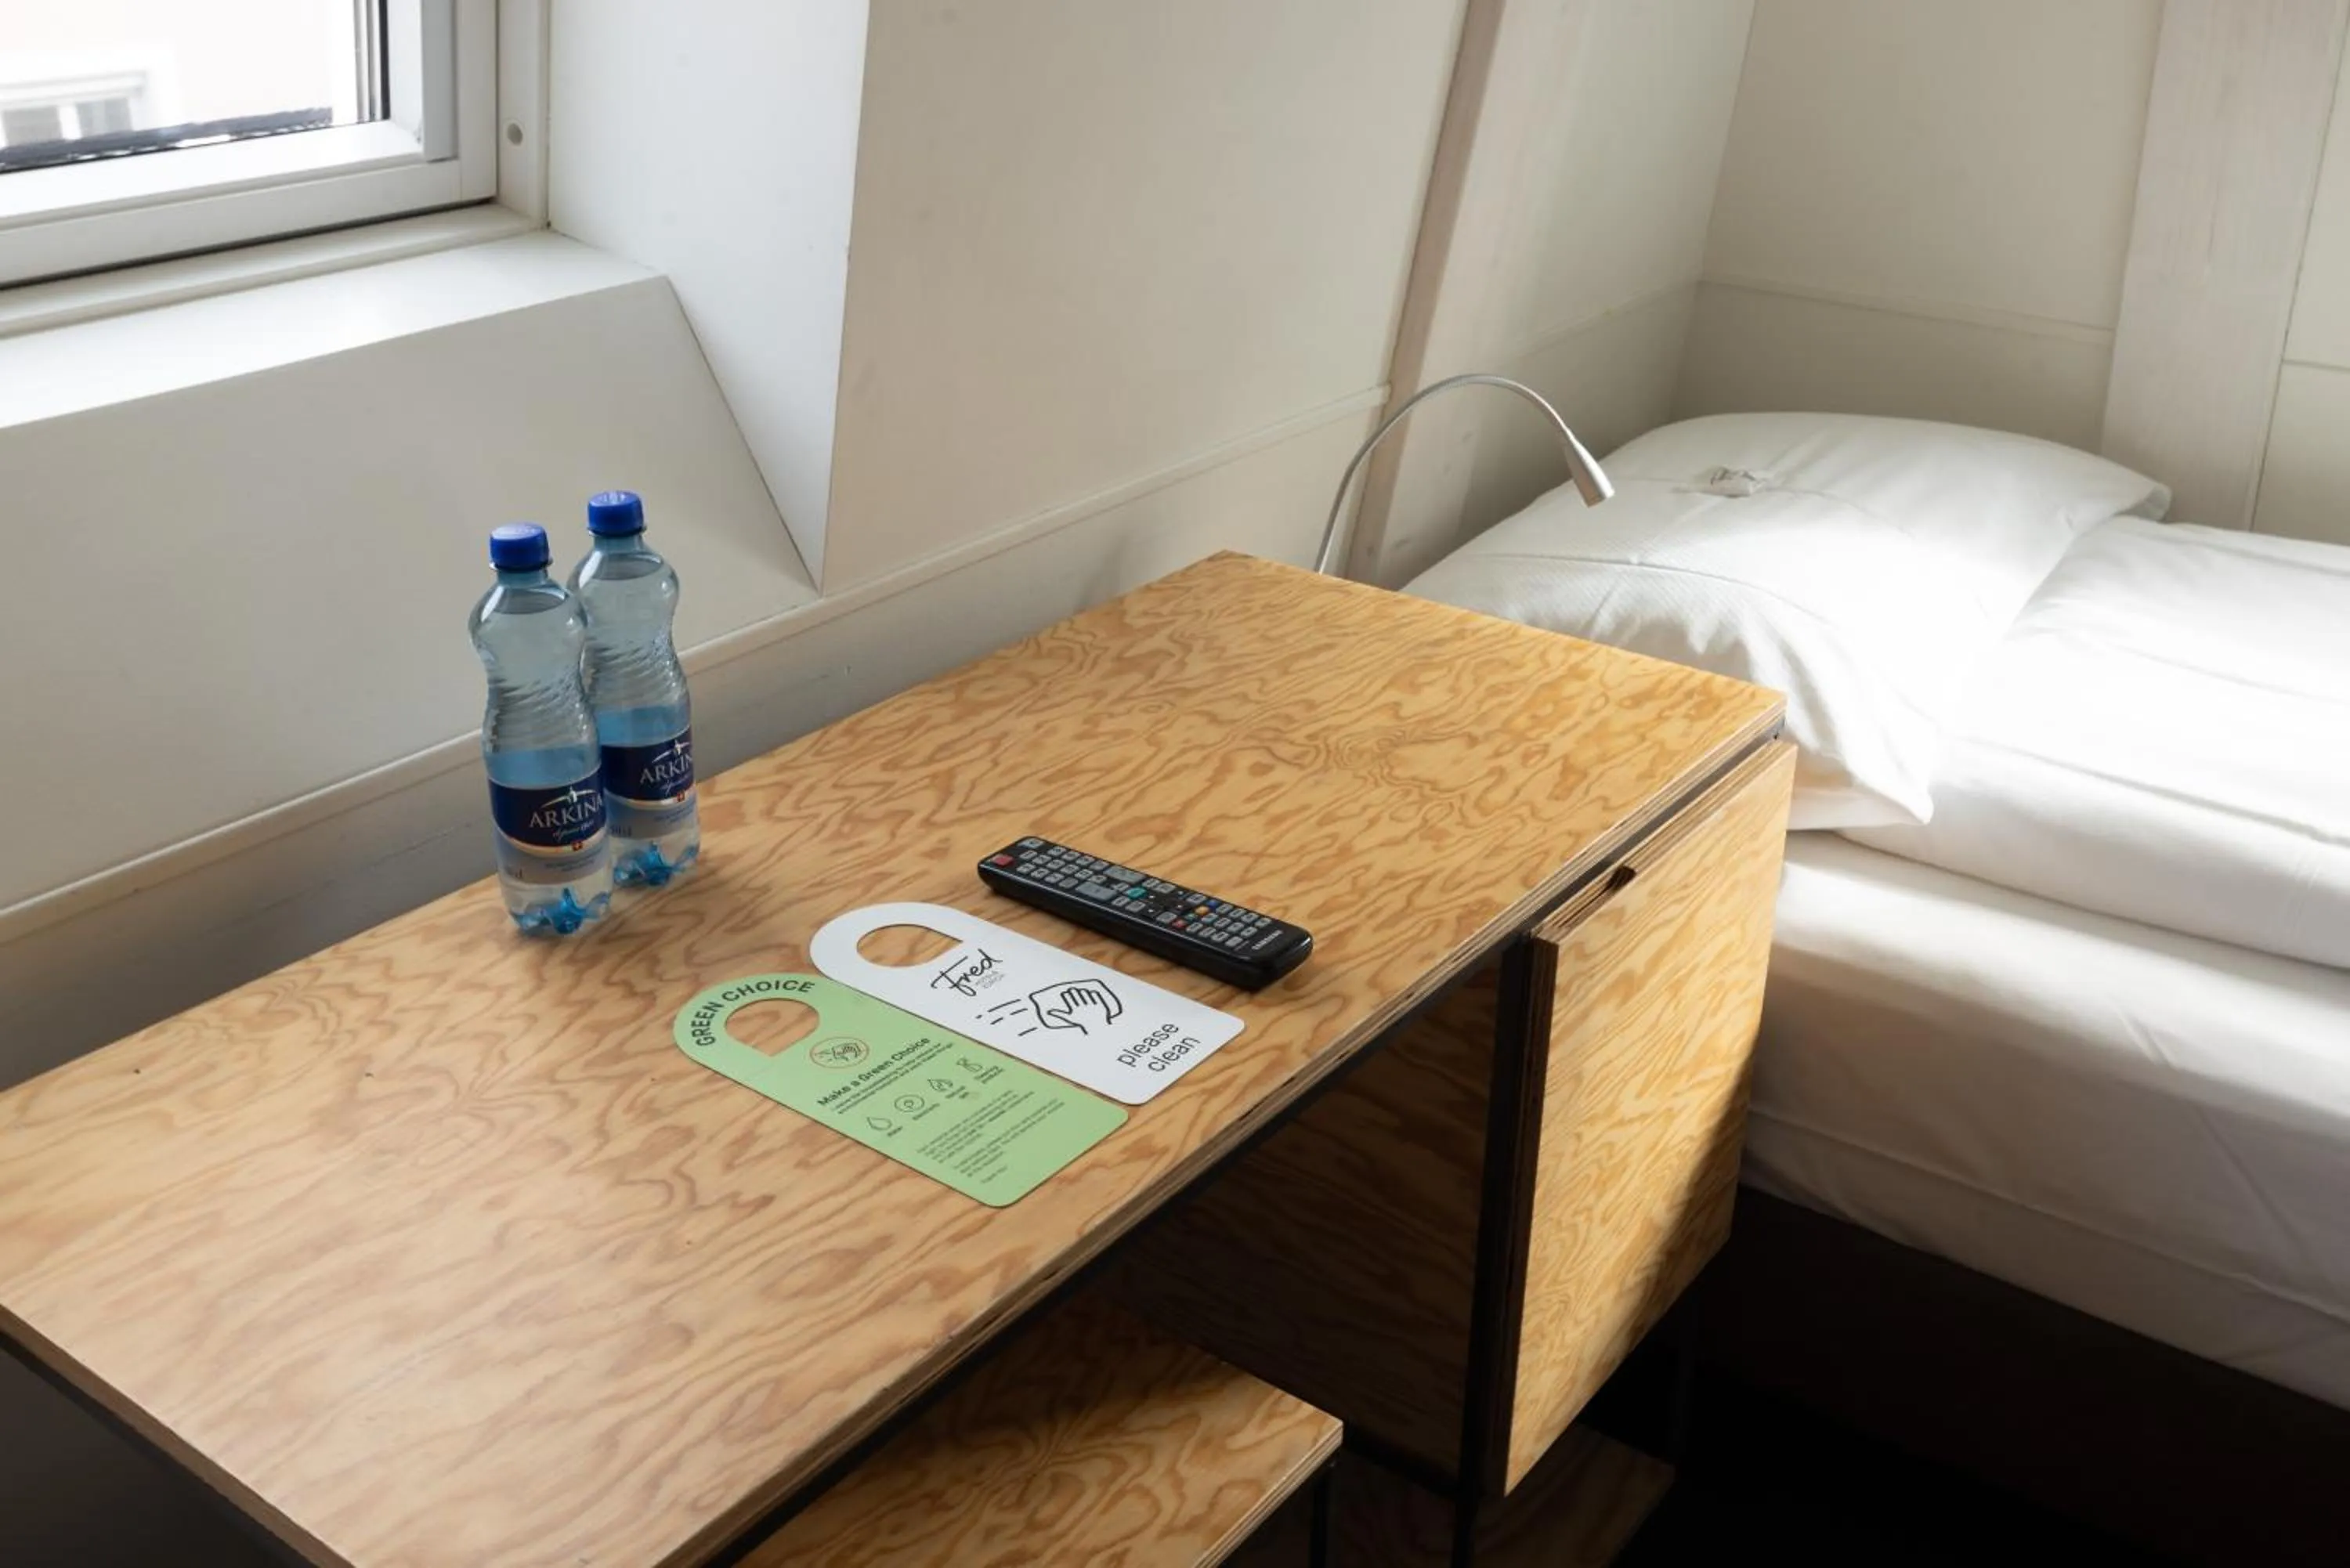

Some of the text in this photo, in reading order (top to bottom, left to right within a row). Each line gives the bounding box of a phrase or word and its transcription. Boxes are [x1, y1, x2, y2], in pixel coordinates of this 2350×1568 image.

[931, 948, 1003, 997] Fred
[690, 979, 815, 1047] GREEN CHOICE
[1116, 1023, 1180, 1068] please
[1148, 1036, 1202, 1072] clean
[817, 1085, 851, 1106] Make
[858, 1060, 895, 1082] Green
[891, 1037, 931, 1061] Choice
